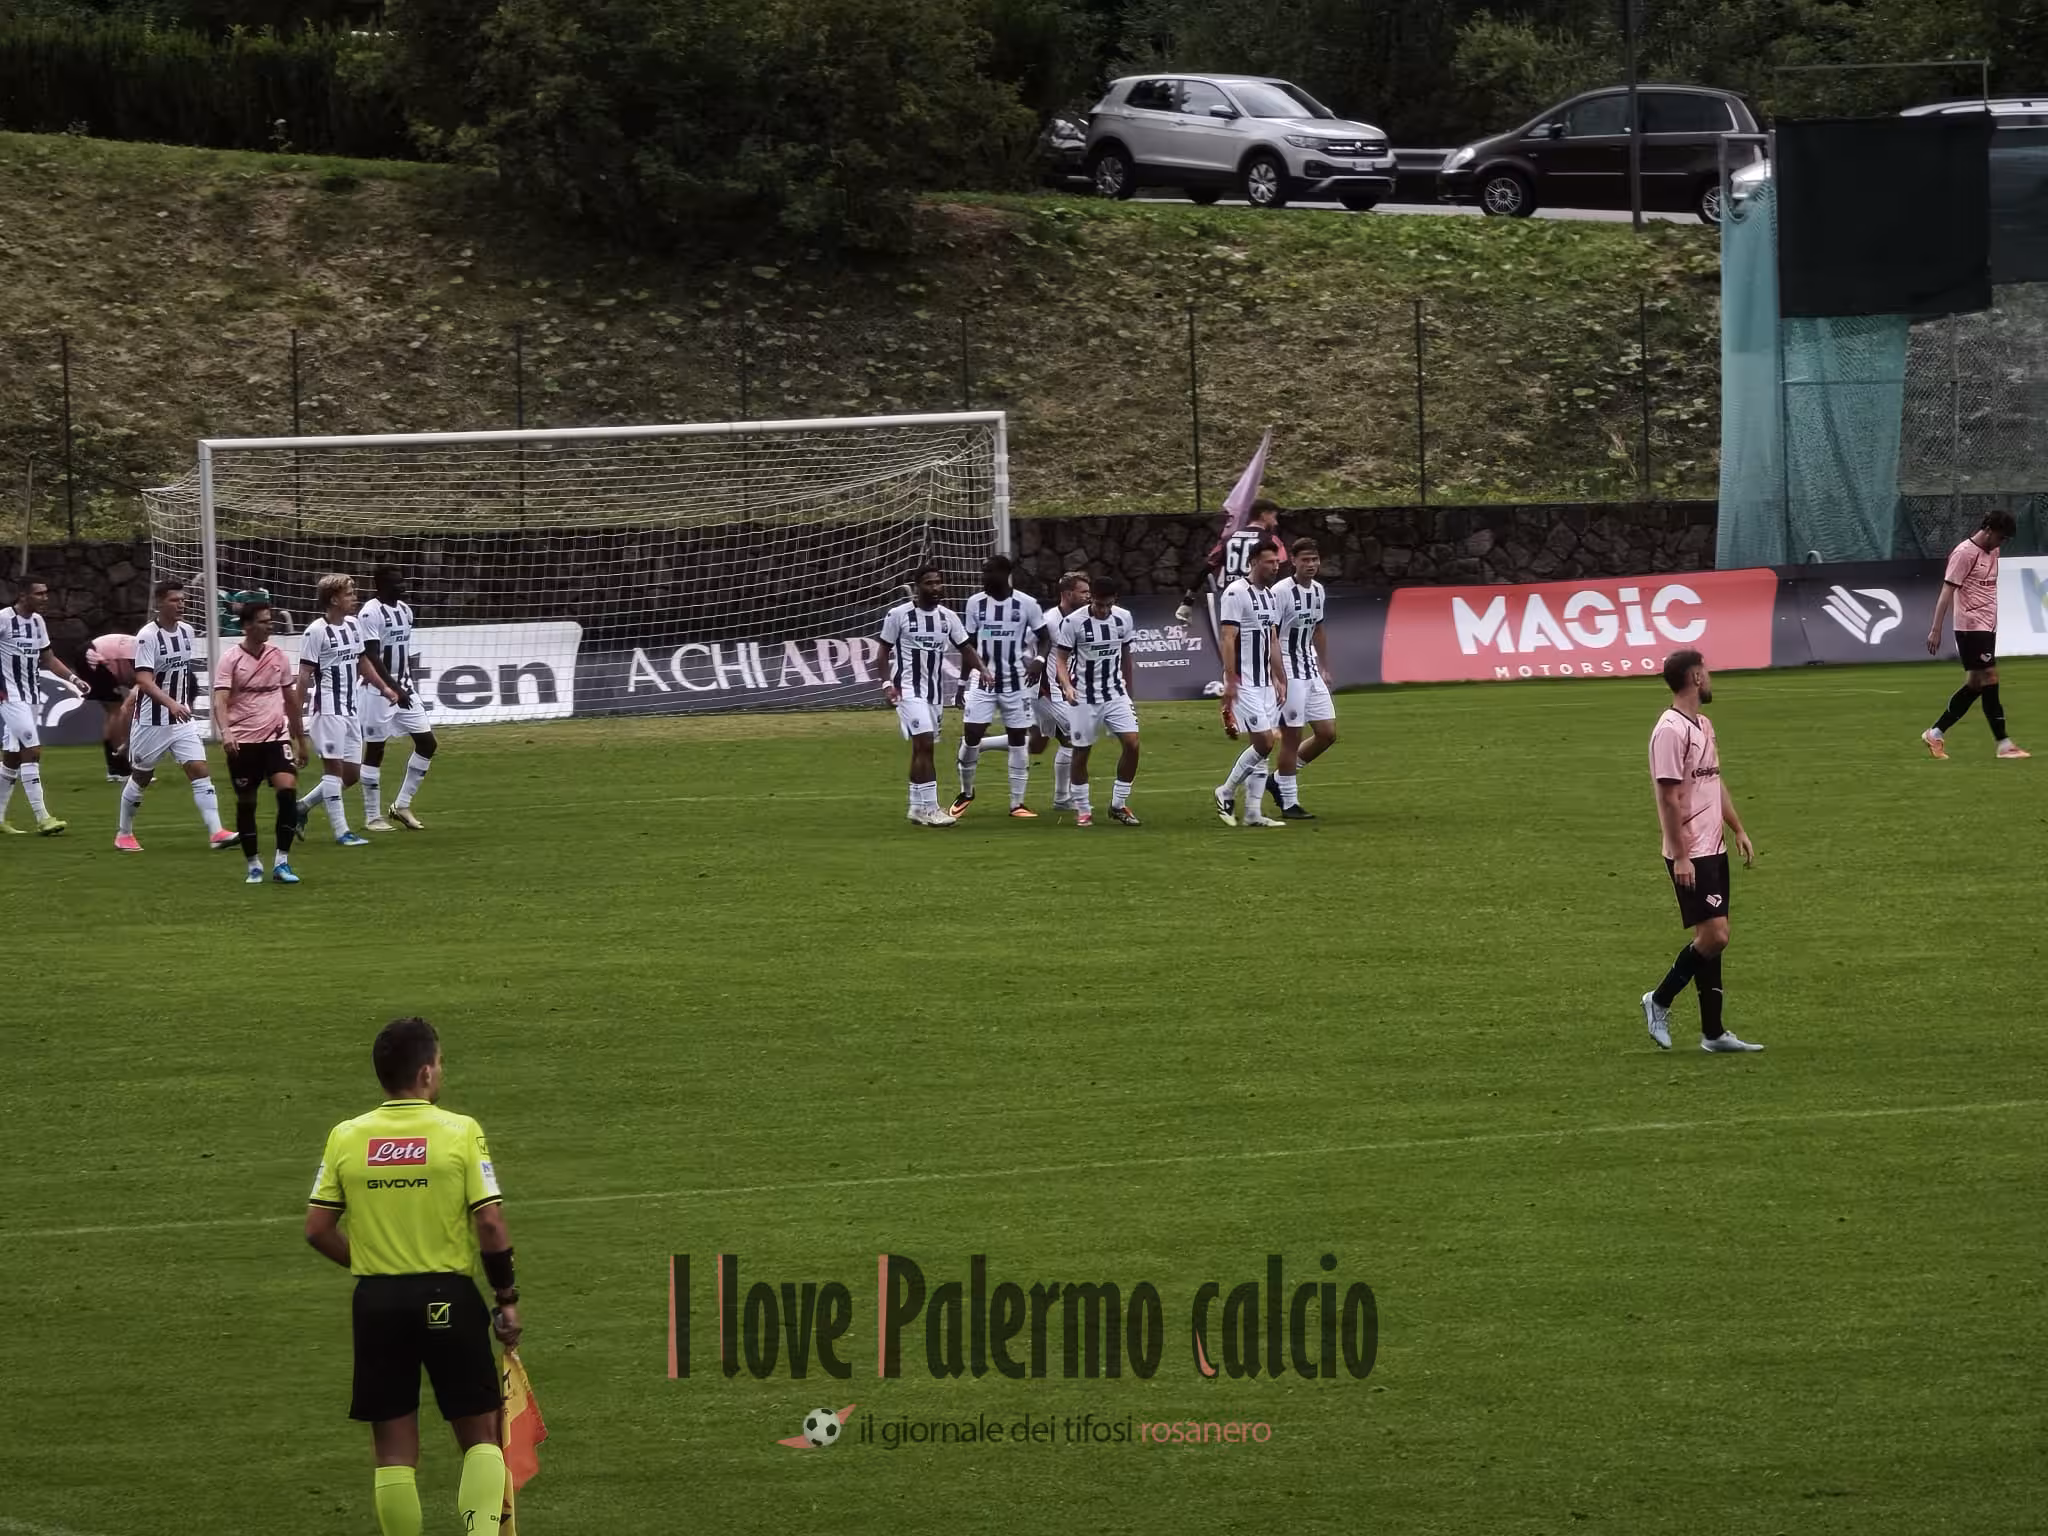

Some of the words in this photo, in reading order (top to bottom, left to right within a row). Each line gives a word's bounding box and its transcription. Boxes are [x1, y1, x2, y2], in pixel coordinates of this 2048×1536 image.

[777, 637, 890, 687] APP
[1494, 656, 1667, 678] MOTORSPO
[368, 1142, 426, 1162] Lete
